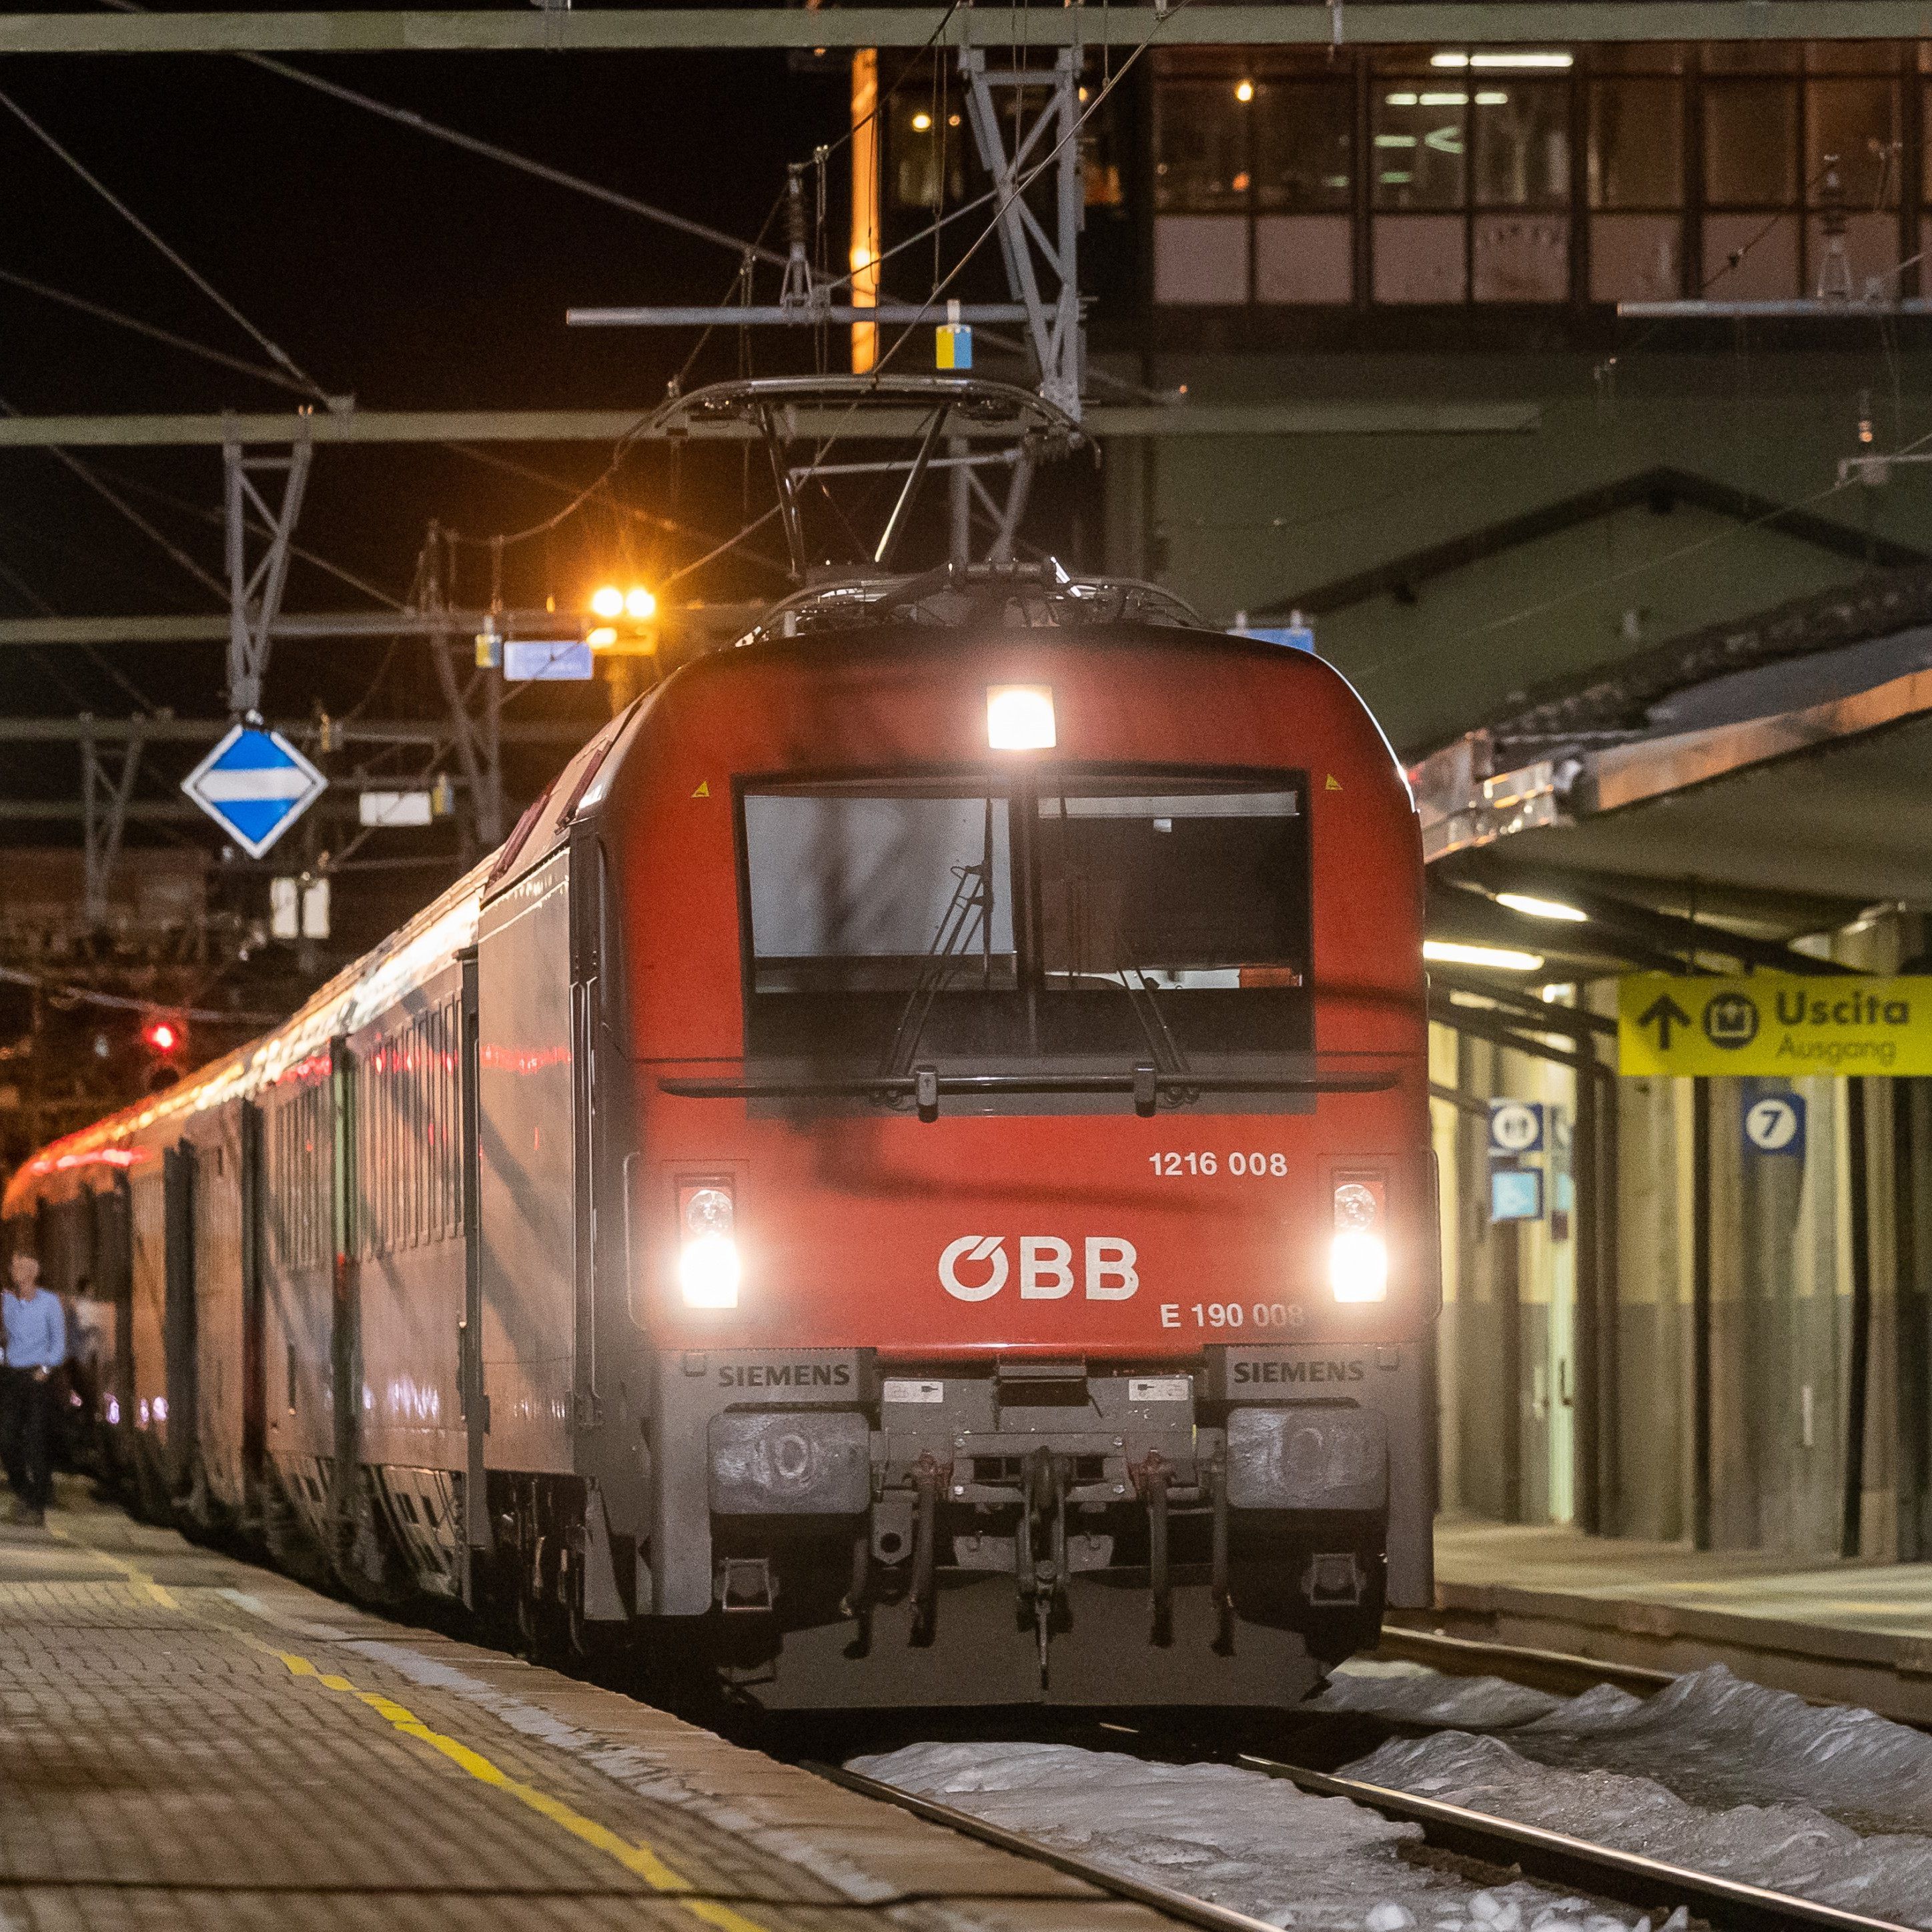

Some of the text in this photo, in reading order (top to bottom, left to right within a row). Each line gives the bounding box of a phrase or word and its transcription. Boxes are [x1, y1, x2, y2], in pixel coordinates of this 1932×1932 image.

[1775, 990, 1910, 1025] Uscita
[1777, 1035, 1897, 1065] Ausgang
[1759, 1109, 1782, 1138] 7
[1149, 1152, 1288, 1177] 1216 008
[938, 1235, 1139, 1302] ÖBB
[1160, 1304, 1181, 1328] E
[1191, 1303, 1244, 1328] 190
[718, 1364, 850, 1387] SIEMENS
[1234, 1360, 1364, 1383] SIEMENS
